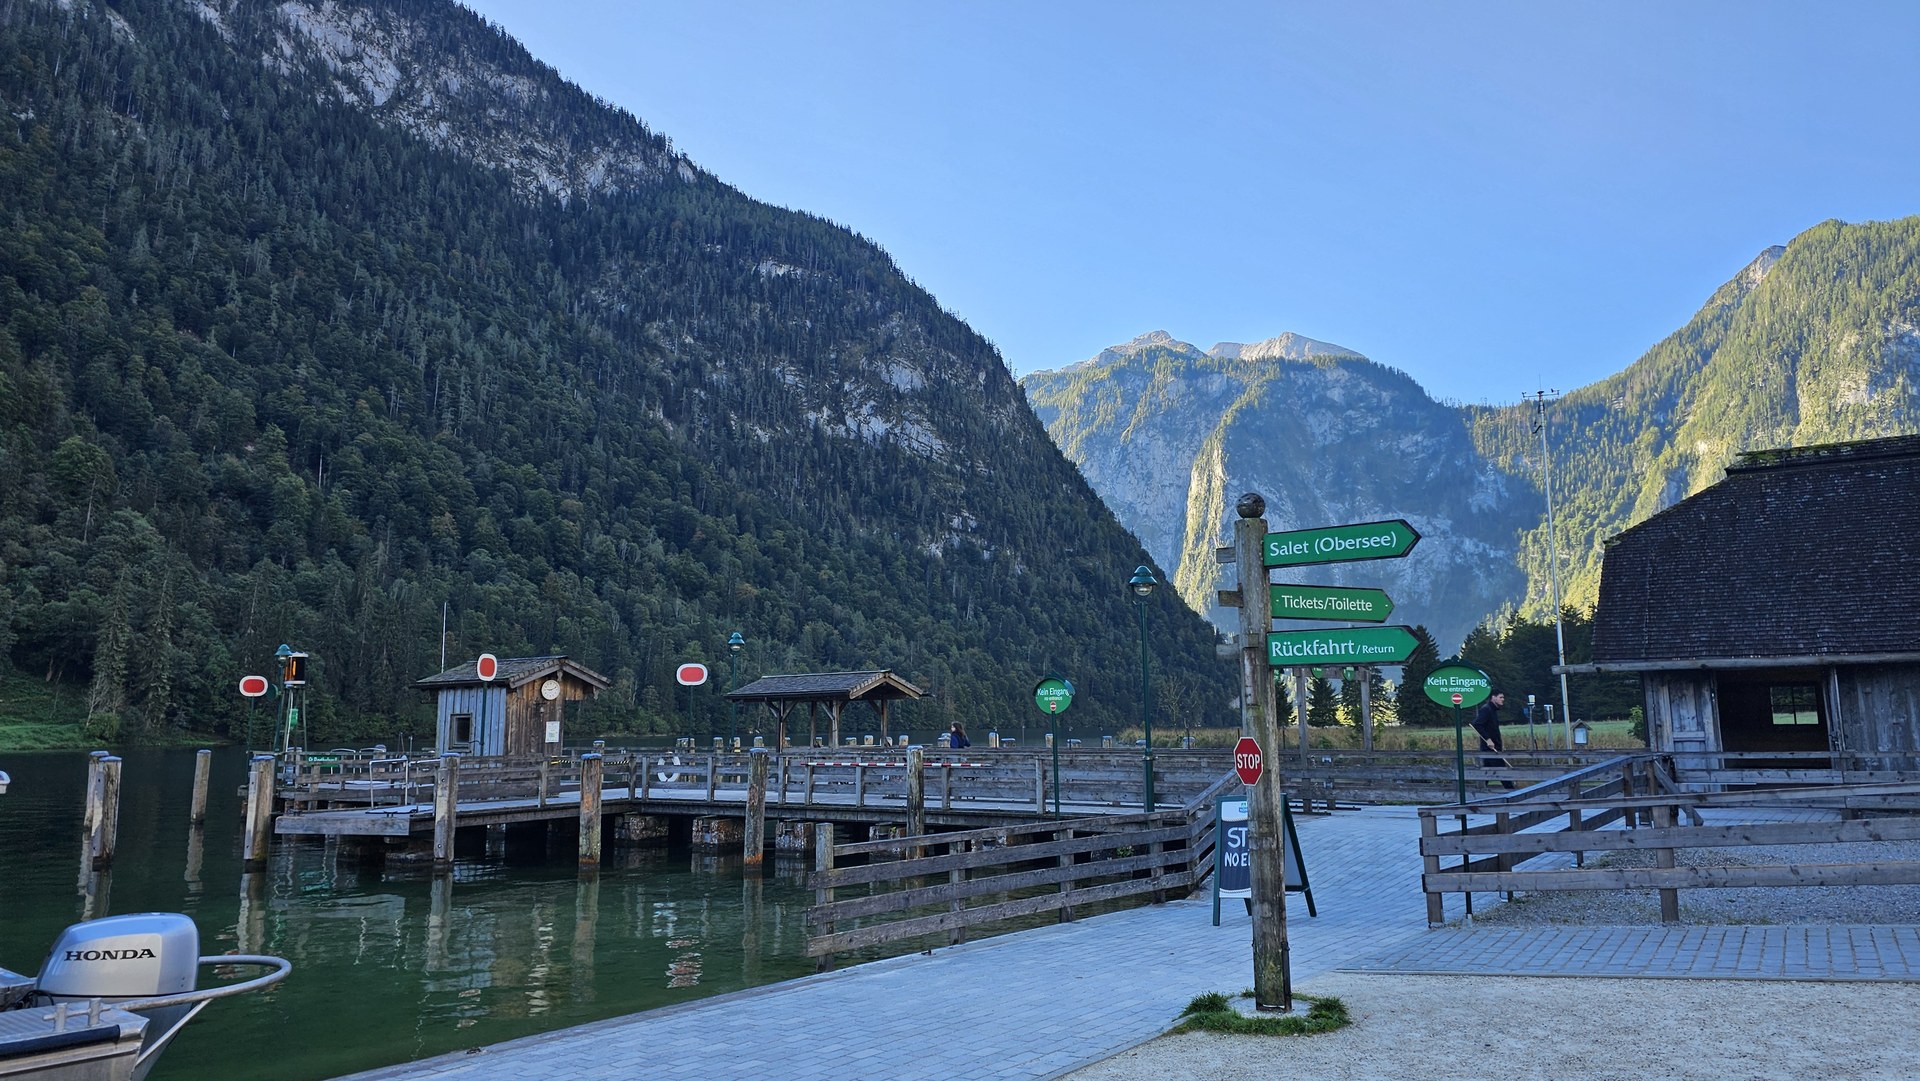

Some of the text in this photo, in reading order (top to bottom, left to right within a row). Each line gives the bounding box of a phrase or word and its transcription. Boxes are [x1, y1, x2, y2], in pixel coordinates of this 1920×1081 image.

[1270, 531, 1397, 556] Salet (Obersee)
[1427, 676, 1488, 687] Kein Eingang
[1037, 687, 1070, 696] Kein Eingang
[1237, 753, 1260, 769] STOP
[1224, 851, 1239, 867] NO
[64, 948, 156, 961] HONDA
